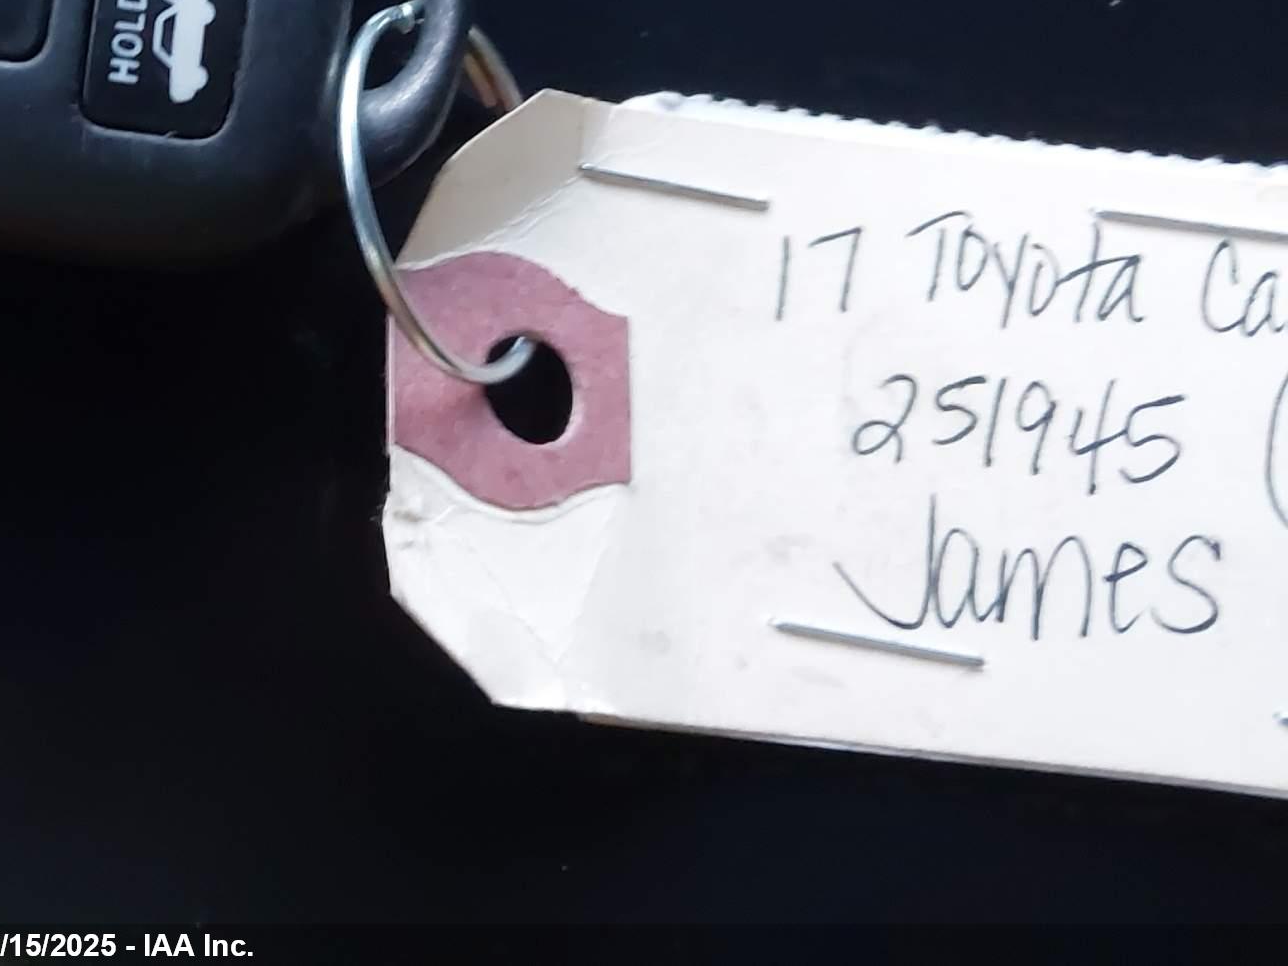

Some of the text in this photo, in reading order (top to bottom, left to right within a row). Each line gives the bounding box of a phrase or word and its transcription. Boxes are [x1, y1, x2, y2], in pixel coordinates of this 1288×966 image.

[774, 228, 863, 321] 17
[906, 210, 1146, 328] Toyota
[852, 373, 1186, 494] 251945
[832, 494, 1224, 641] James
